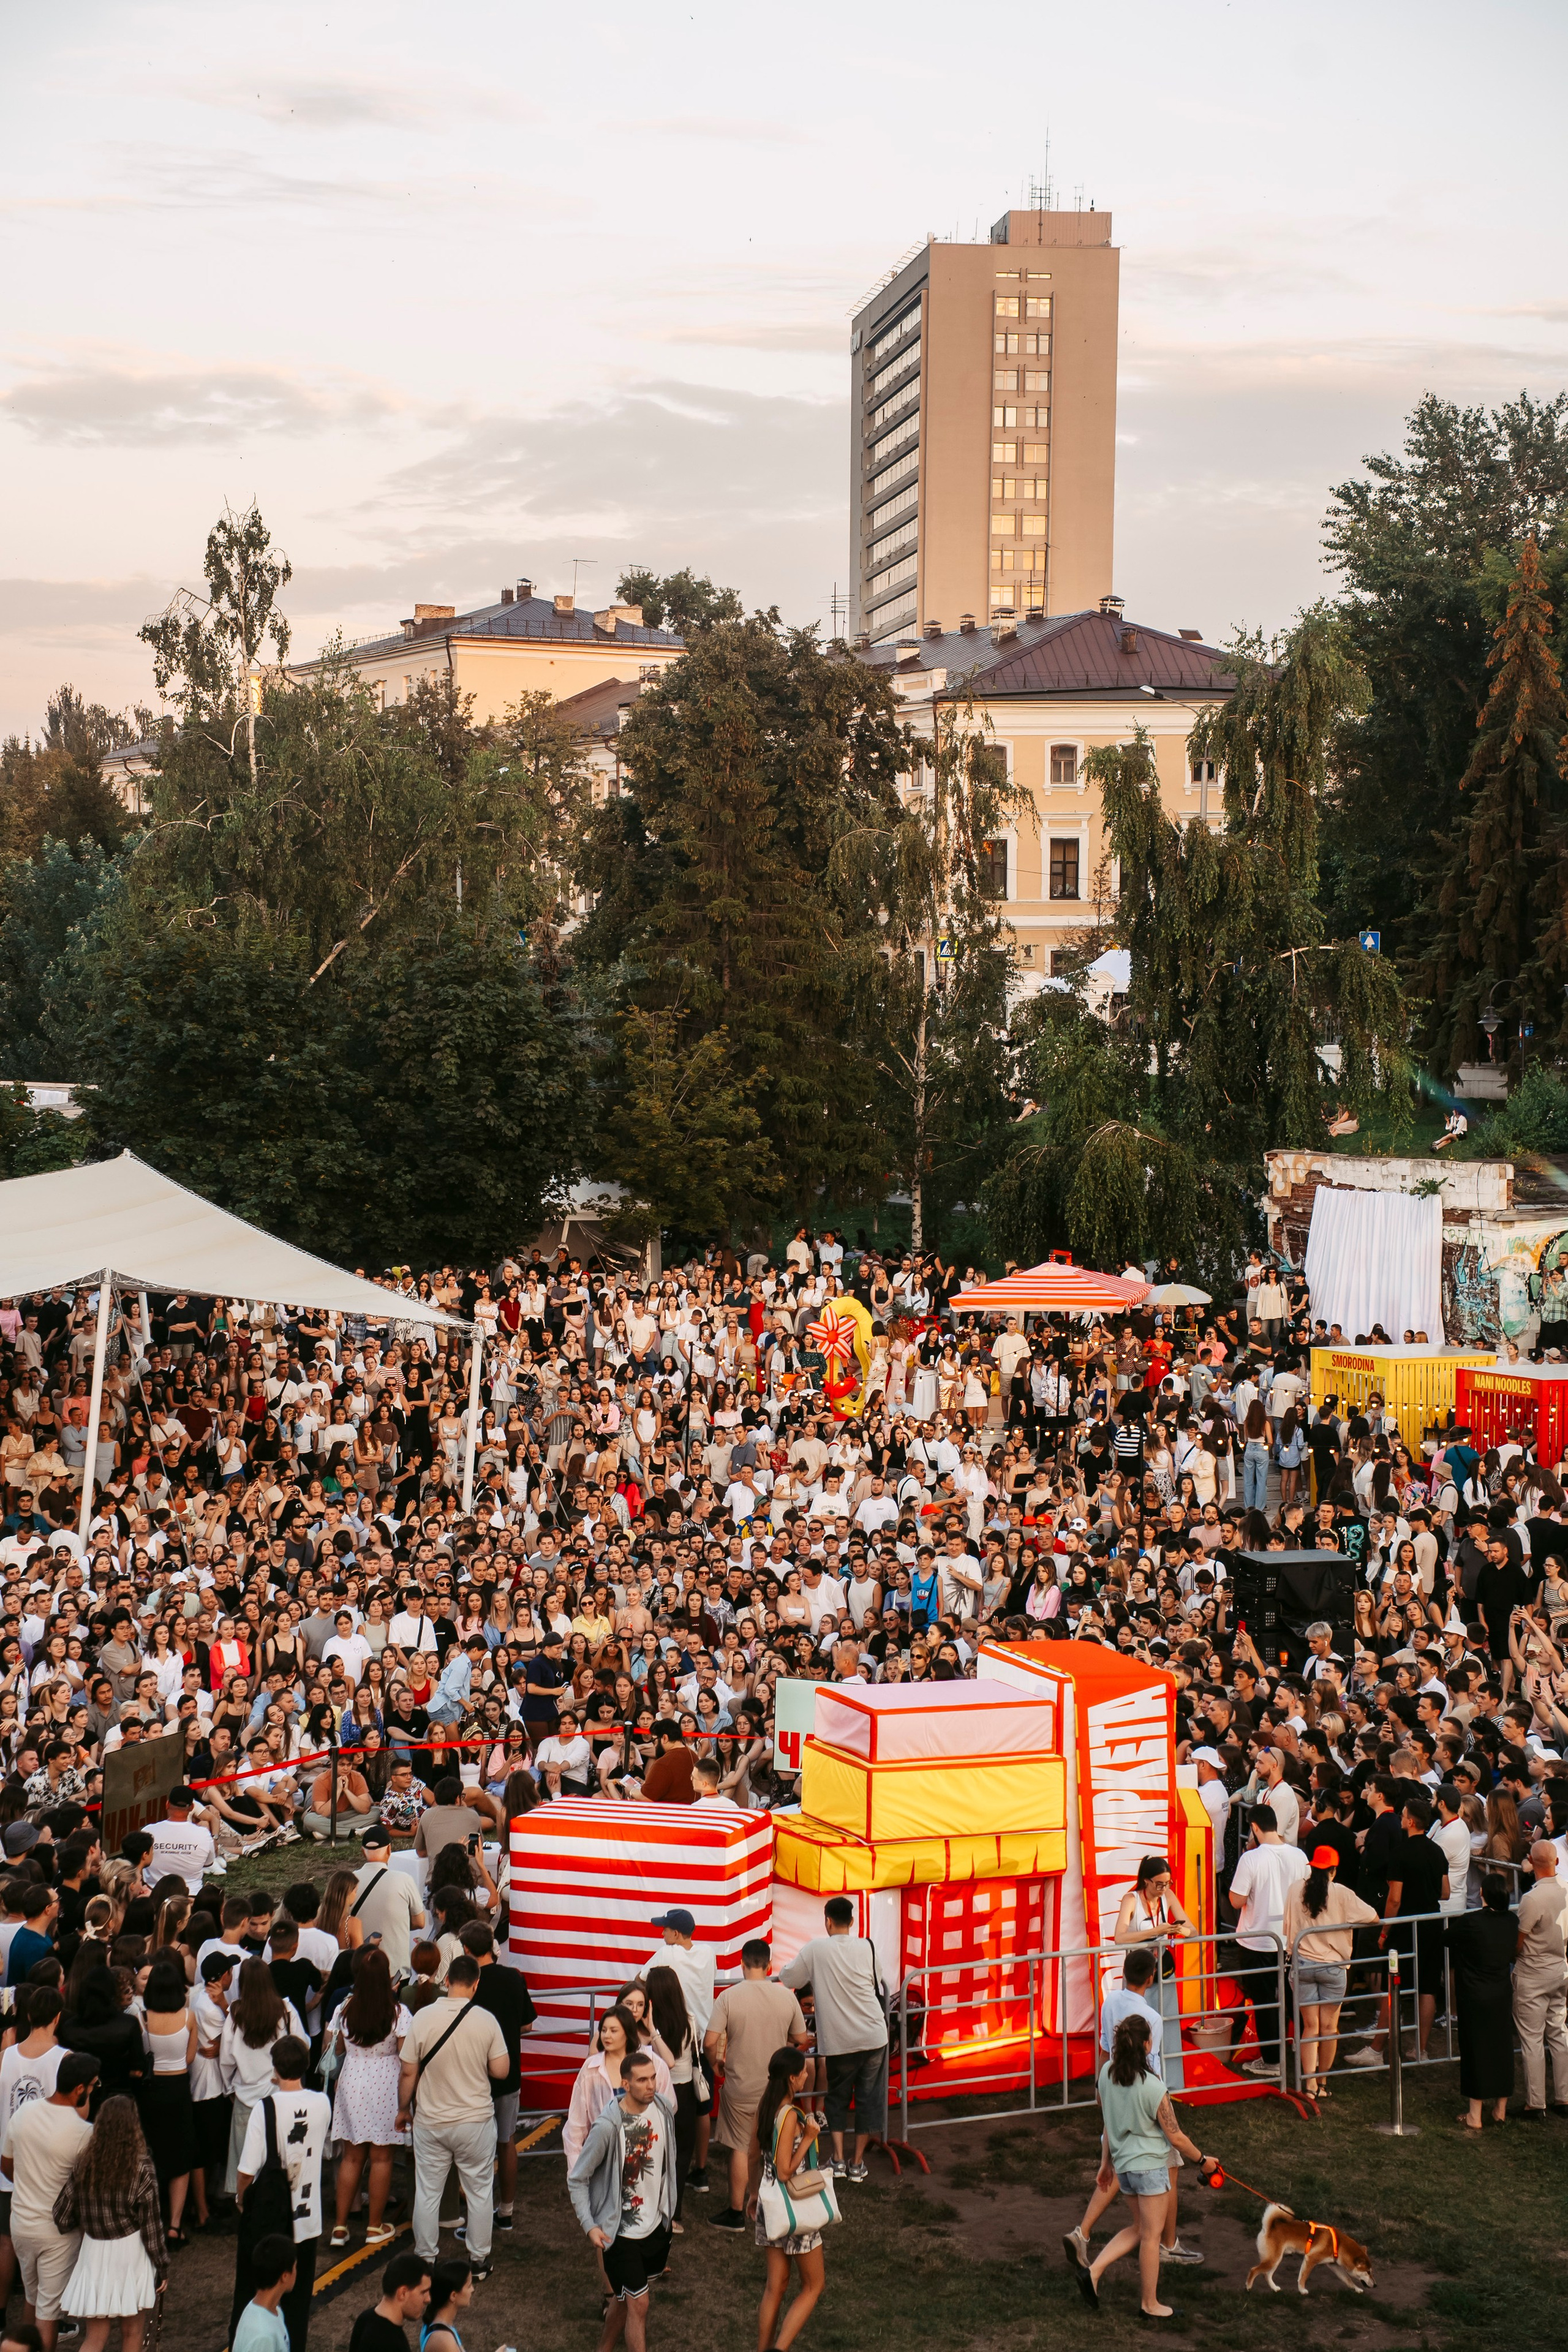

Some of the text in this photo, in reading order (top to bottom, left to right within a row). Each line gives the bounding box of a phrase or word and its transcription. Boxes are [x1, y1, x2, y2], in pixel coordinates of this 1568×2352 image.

[1332, 1354, 1374, 1373] SMORODINA
[1474, 1374, 1531, 1395] NANI NOODLES
[778, 1730, 815, 1770] Ч
[1087, 1683, 1169, 1875] МАРКЕТА
